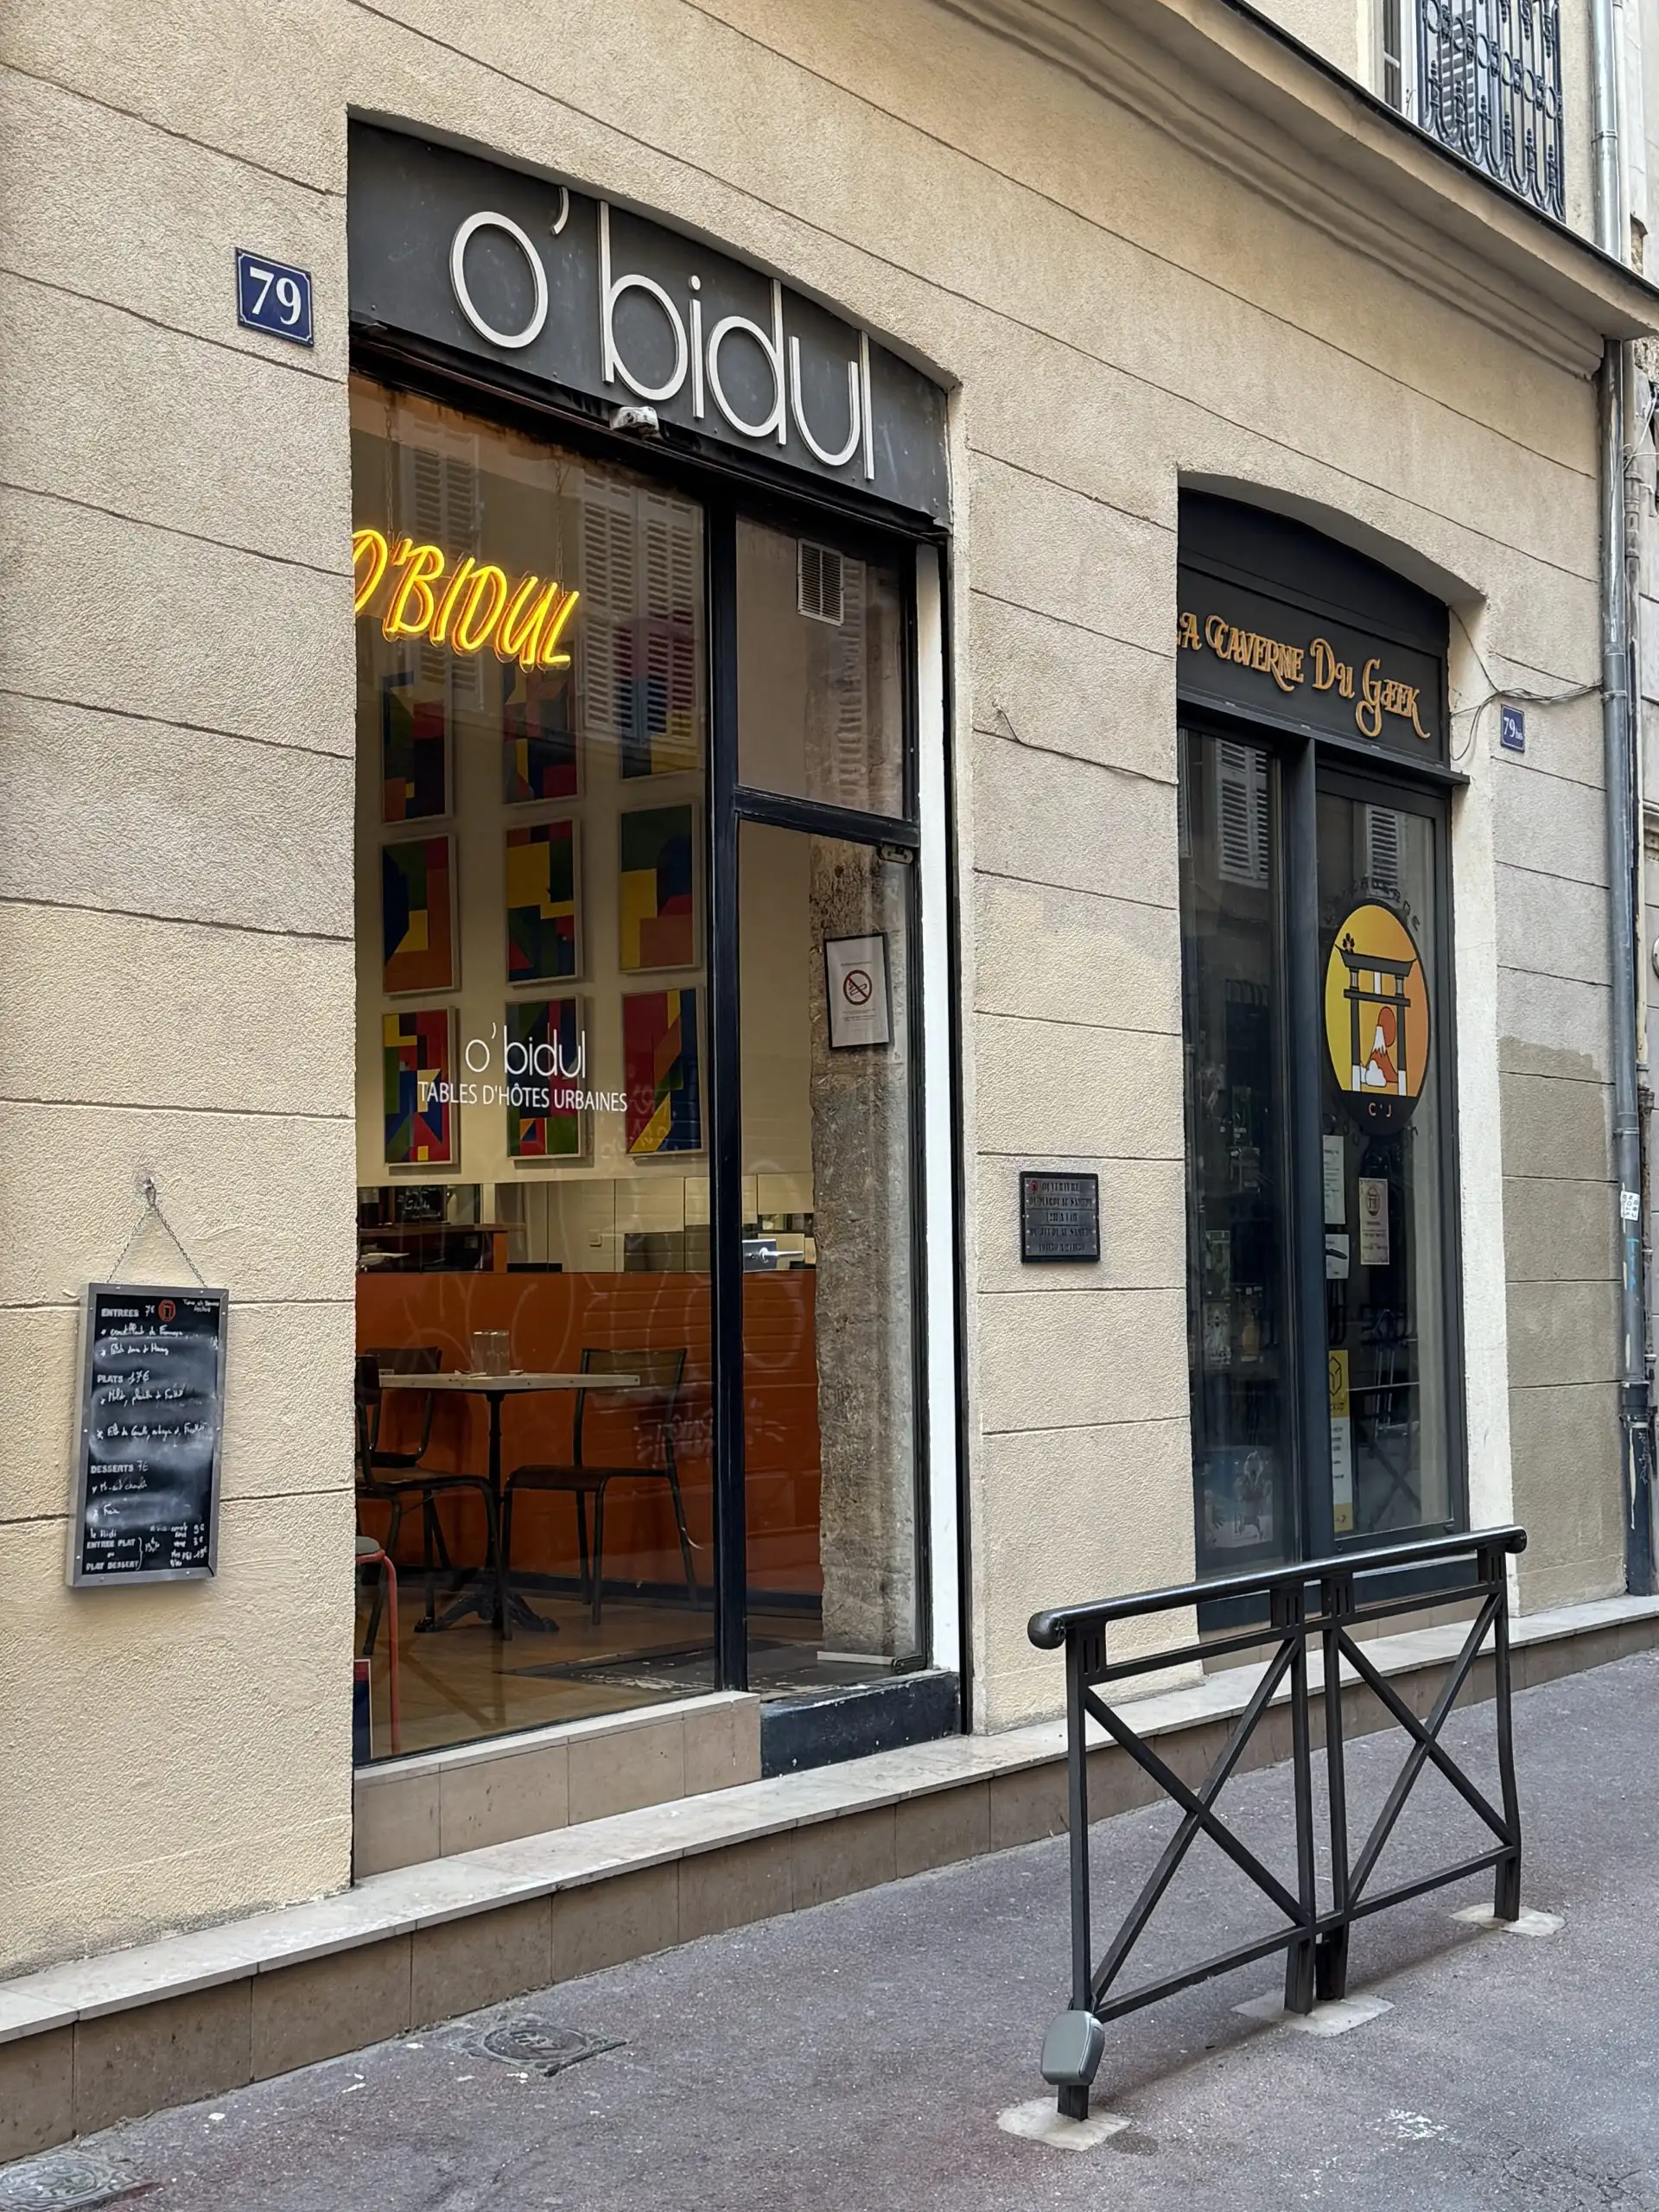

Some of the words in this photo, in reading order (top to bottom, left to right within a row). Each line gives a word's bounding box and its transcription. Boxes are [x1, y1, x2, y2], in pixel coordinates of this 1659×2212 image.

[249, 266, 302, 326] 79
[449, 187, 875, 481] o'bidul
[1177, 612, 1203, 651] A
[465, 1021, 586, 1079] o'bidul
[417, 1081, 477, 1104] TABLES
[482, 1083, 550, 1109] D'HÔTES
[554, 1088, 628, 1112] URBAINES
[97, 1374, 124, 1383] PLATS
[90, 1464, 134, 1474] DESSERTS
